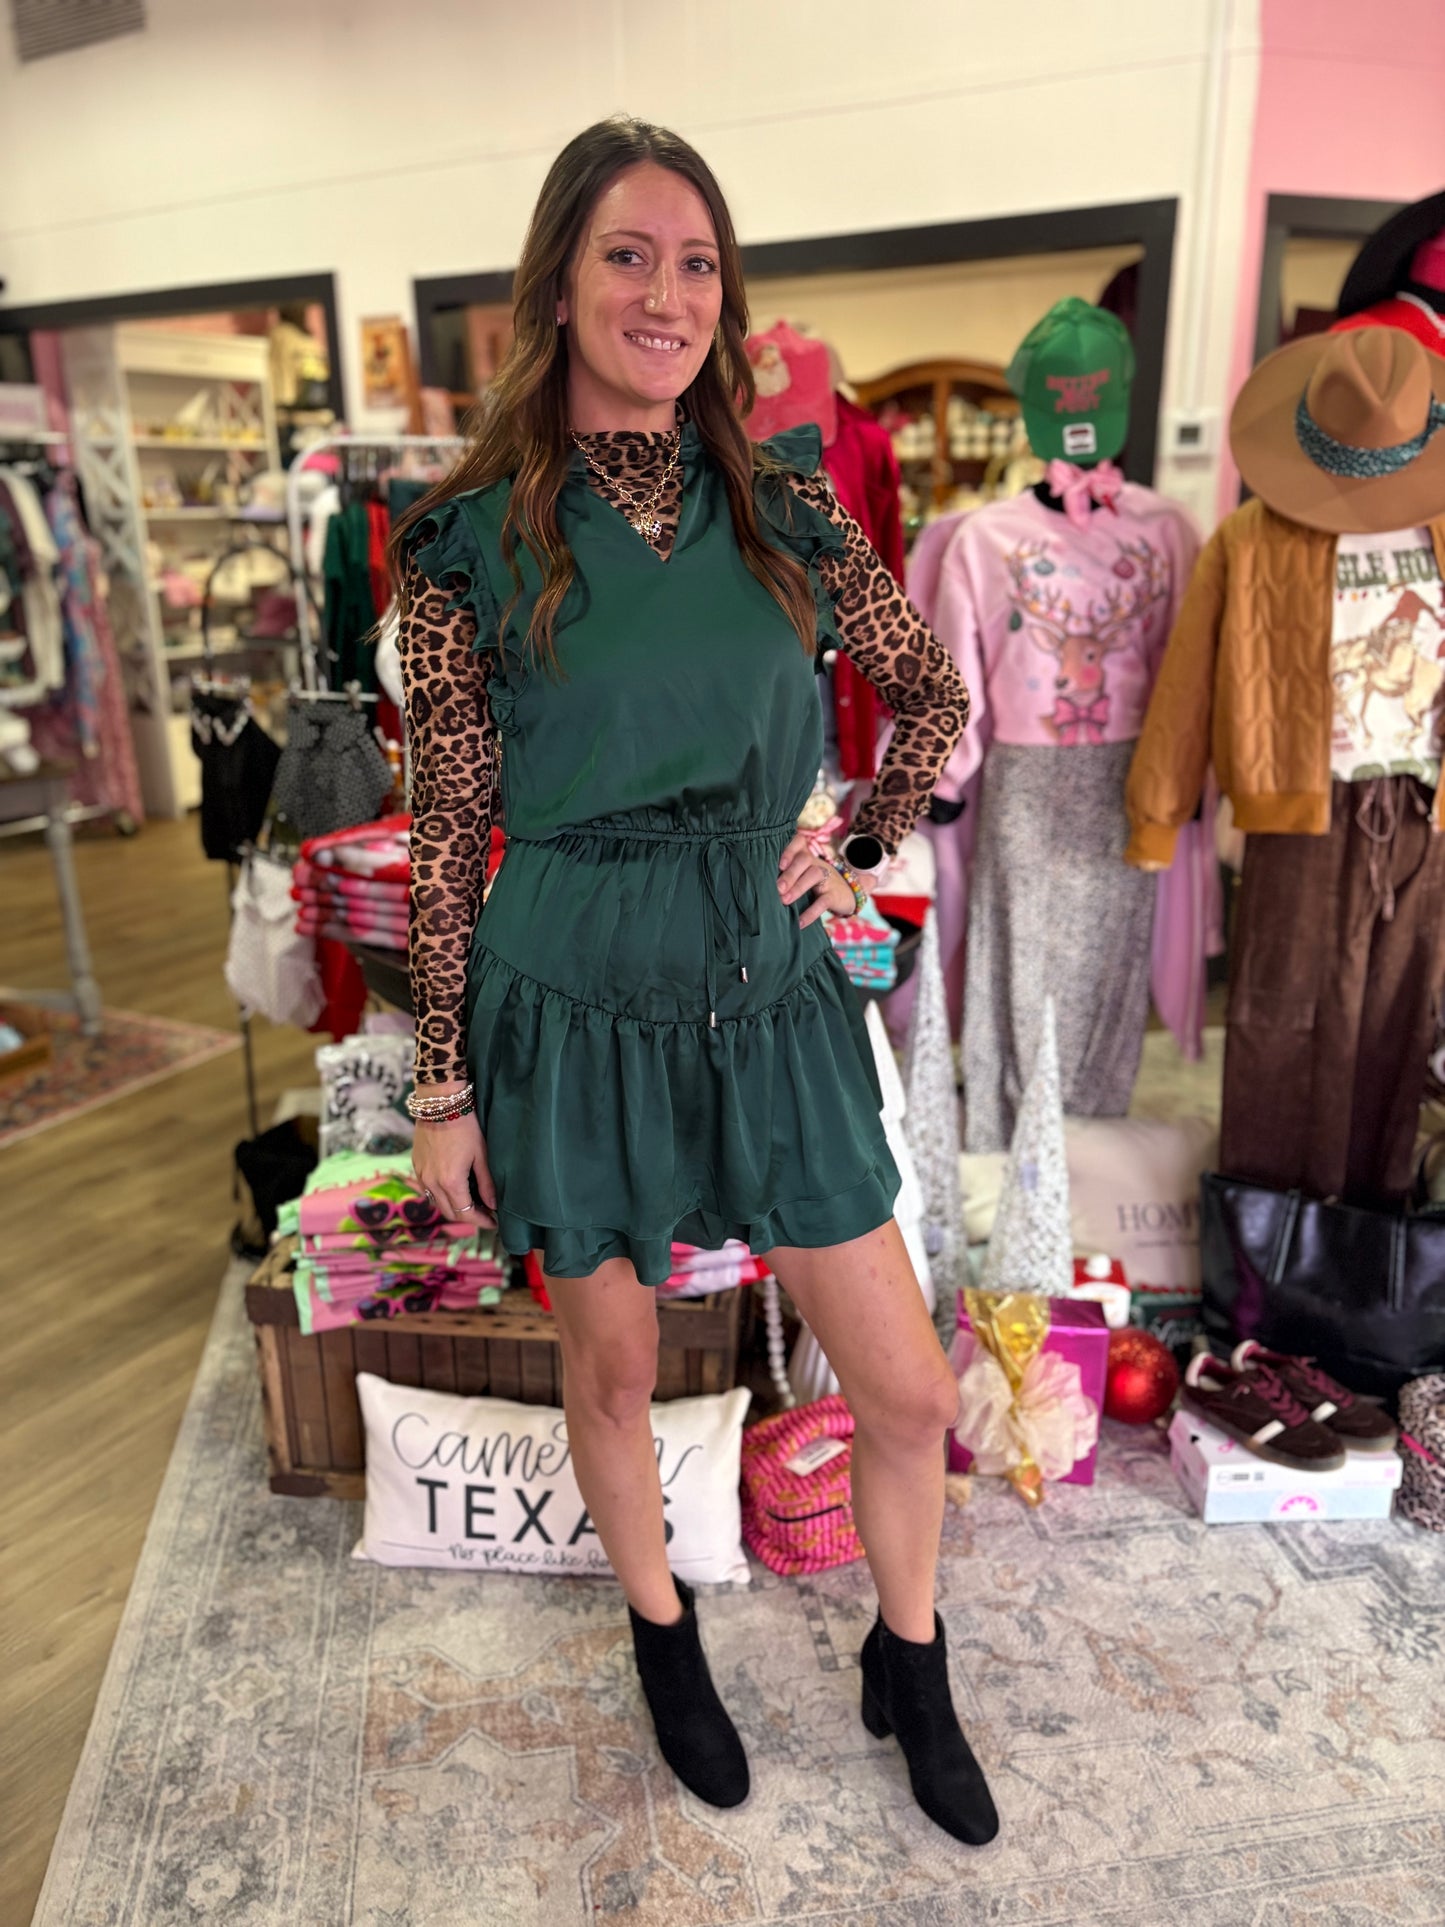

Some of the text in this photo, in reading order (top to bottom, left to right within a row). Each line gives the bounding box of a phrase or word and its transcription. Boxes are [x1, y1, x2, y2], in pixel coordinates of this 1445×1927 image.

[1117, 1202, 1199, 1232] HOM
[392, 1412, 703, 1487] Came
[416, 1477, 674, 1546] TEX
[483, 1546, 539, 1567] place
[542, 1549, 583, 1567] like
[585, 1549, 610, 1569] ho
